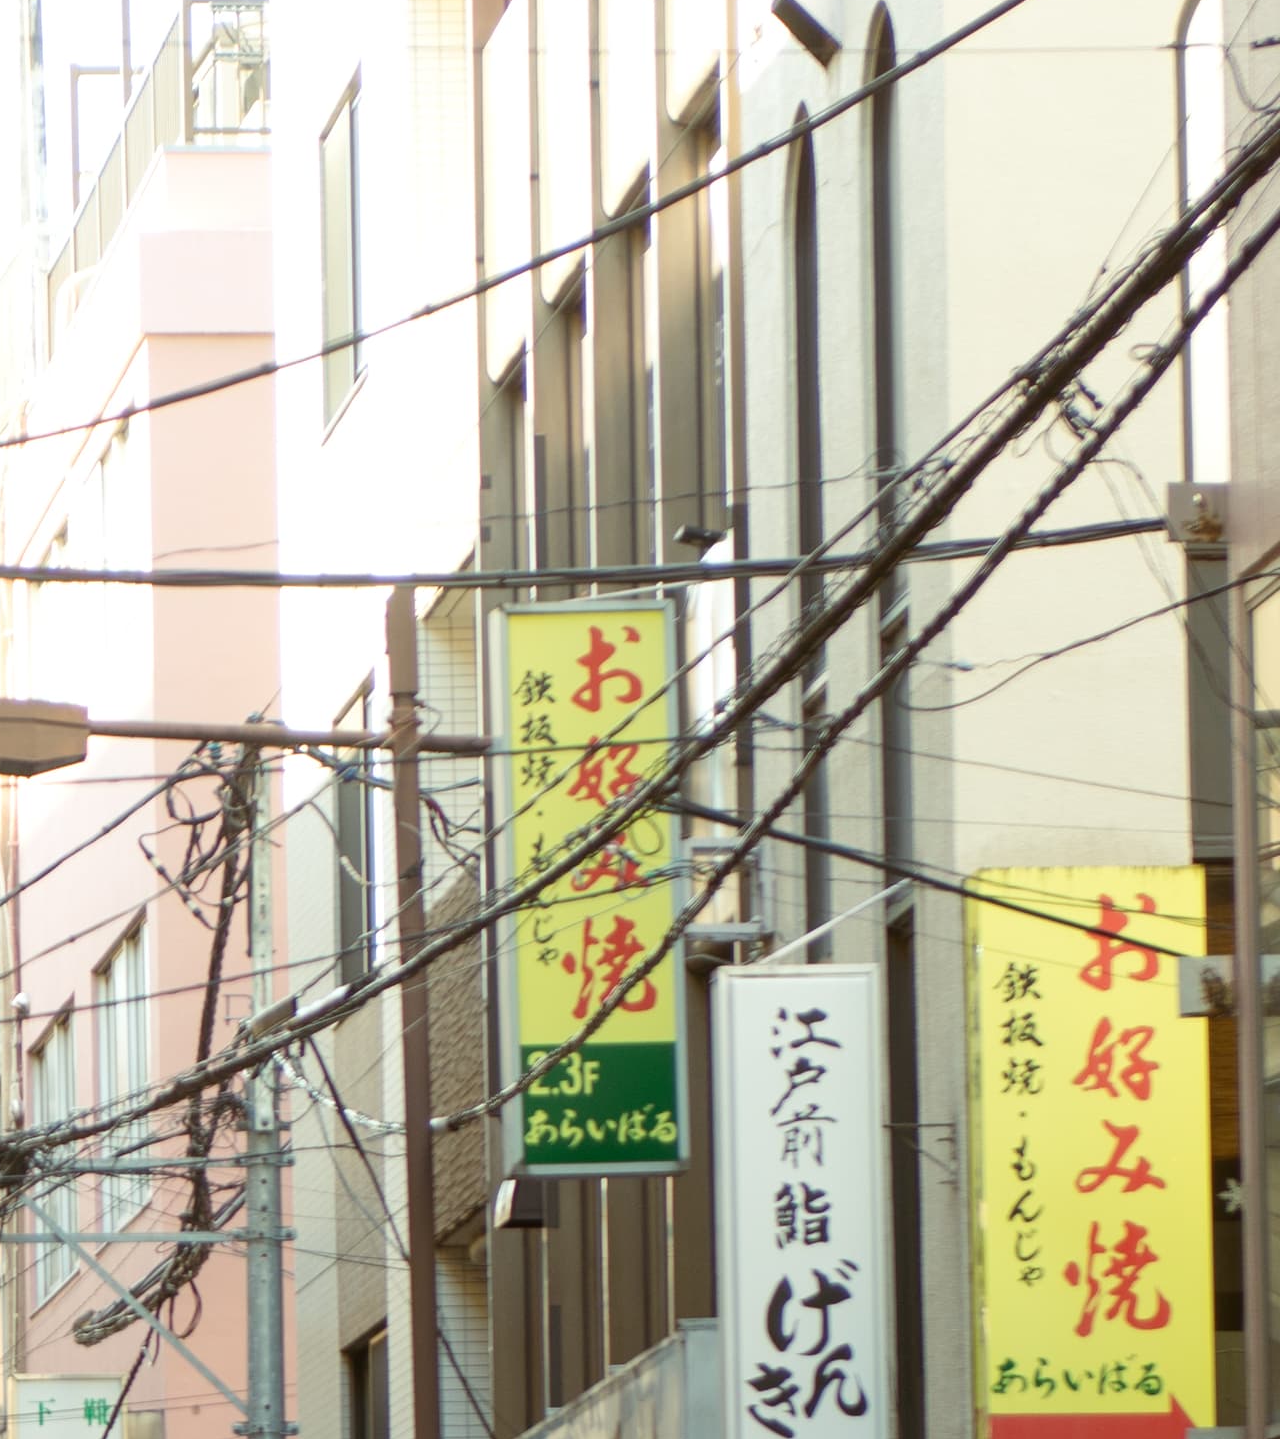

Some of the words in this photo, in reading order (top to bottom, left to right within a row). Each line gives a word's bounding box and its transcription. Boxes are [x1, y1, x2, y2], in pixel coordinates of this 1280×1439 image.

[513, 668, 560, 966] 鉄板焼・もじゃ
[524, 1102, 678, 1148] あらいばる
[769, 1007, 840, 1250] 江戸前鮨
[993, 962, 1042, 1287] 鉄板焼・もんじゃ
[1063, 892, 1171, 1338] お好み焼
[746, 1257, 869, 1439] げんき
[990, 1355, 1165, 1400] あらいばる
